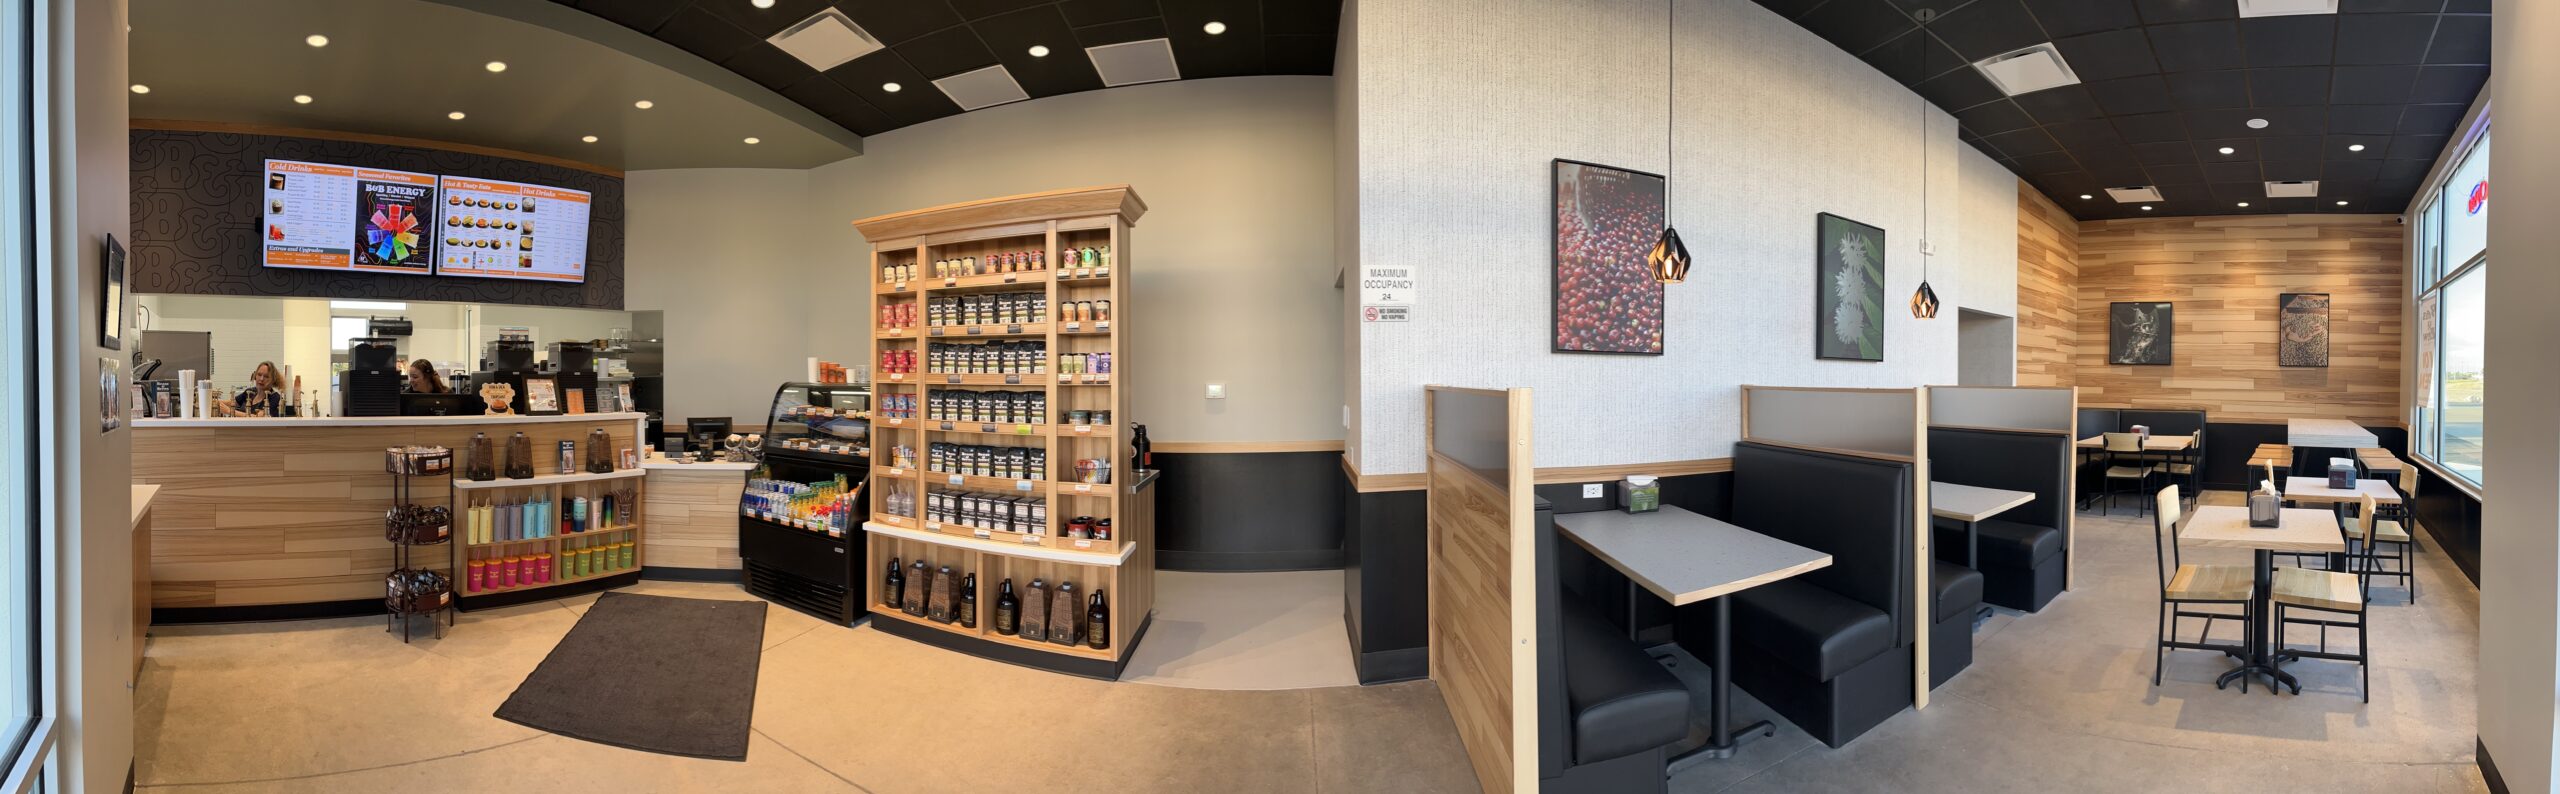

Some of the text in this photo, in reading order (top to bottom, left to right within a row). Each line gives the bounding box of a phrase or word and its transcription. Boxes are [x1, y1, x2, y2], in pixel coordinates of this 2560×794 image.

[387, 186, 425, 196] ENERGY
[1370, 269, 1407, 277] MAXIMUM
[1364, 280, 1413, 289] OCCUPANCY
